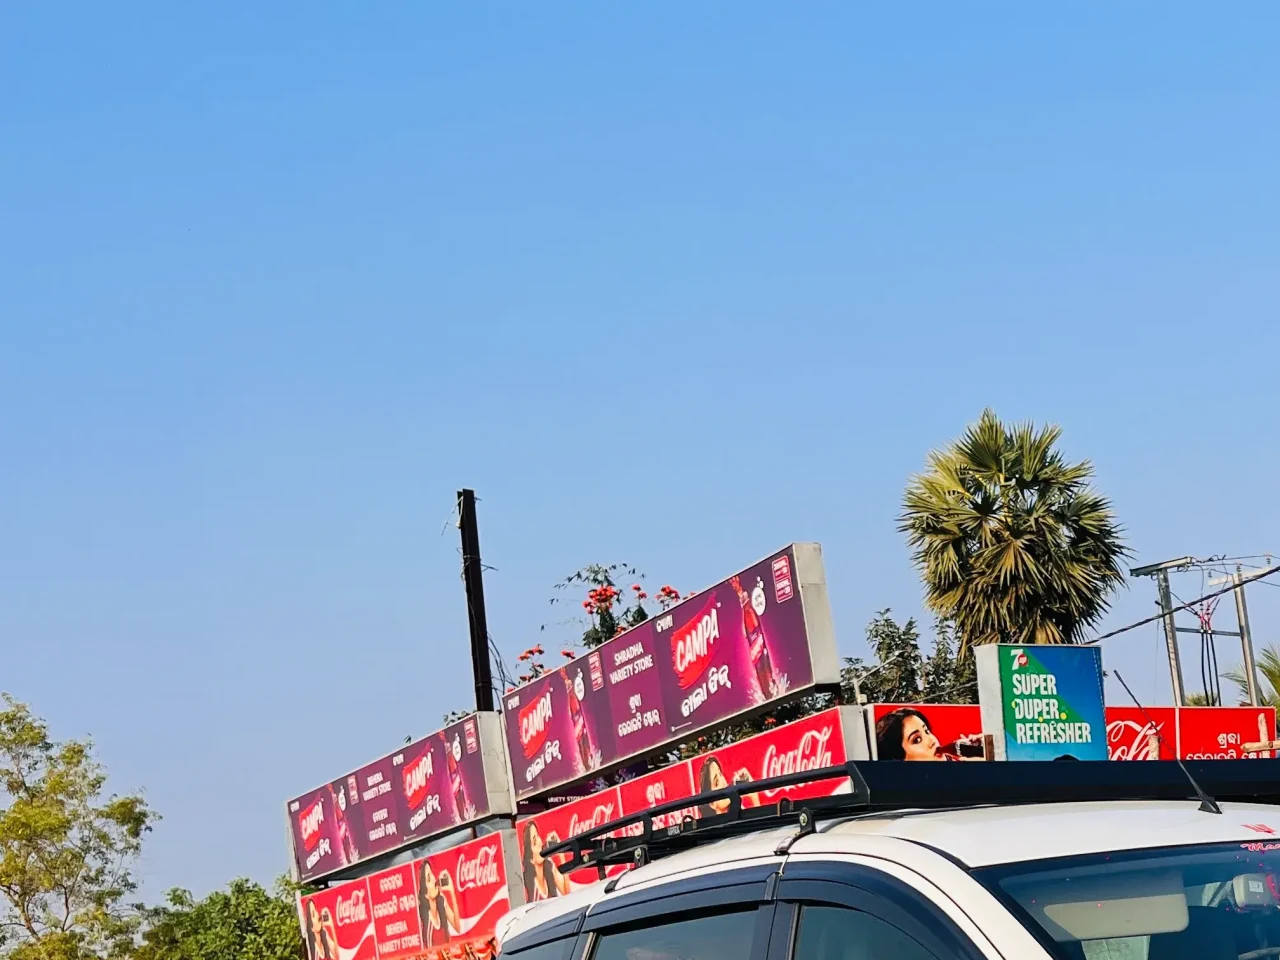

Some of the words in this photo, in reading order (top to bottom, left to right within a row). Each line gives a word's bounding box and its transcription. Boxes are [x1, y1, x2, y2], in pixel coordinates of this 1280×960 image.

[614, 642, 644, 666] SHRADHA
[676, 608, 720, 672] CAMPA
[609, 662, 634, 685] VARIETY
[633, 654, 654, 674] STORE
[1012, 673, 1057, 695] SUPER
[521, 691, 553, 744] CAMPA
[1014, 698, 1060, 720] DUPER
[1015, 721, 1092, 744] REFRESHER
[405, 751, 434, 797] CAMPA
[301, 800, 324, 840] CAMPA
[456, 844, 500, 892] Coca-Cola
[336, 889, 367, 927] Coca-Cola
[385, 919, 408, 937] BEHERA
[378, 938, 400, 955] VARIETY
[401, 933, 420, 949] STORE
